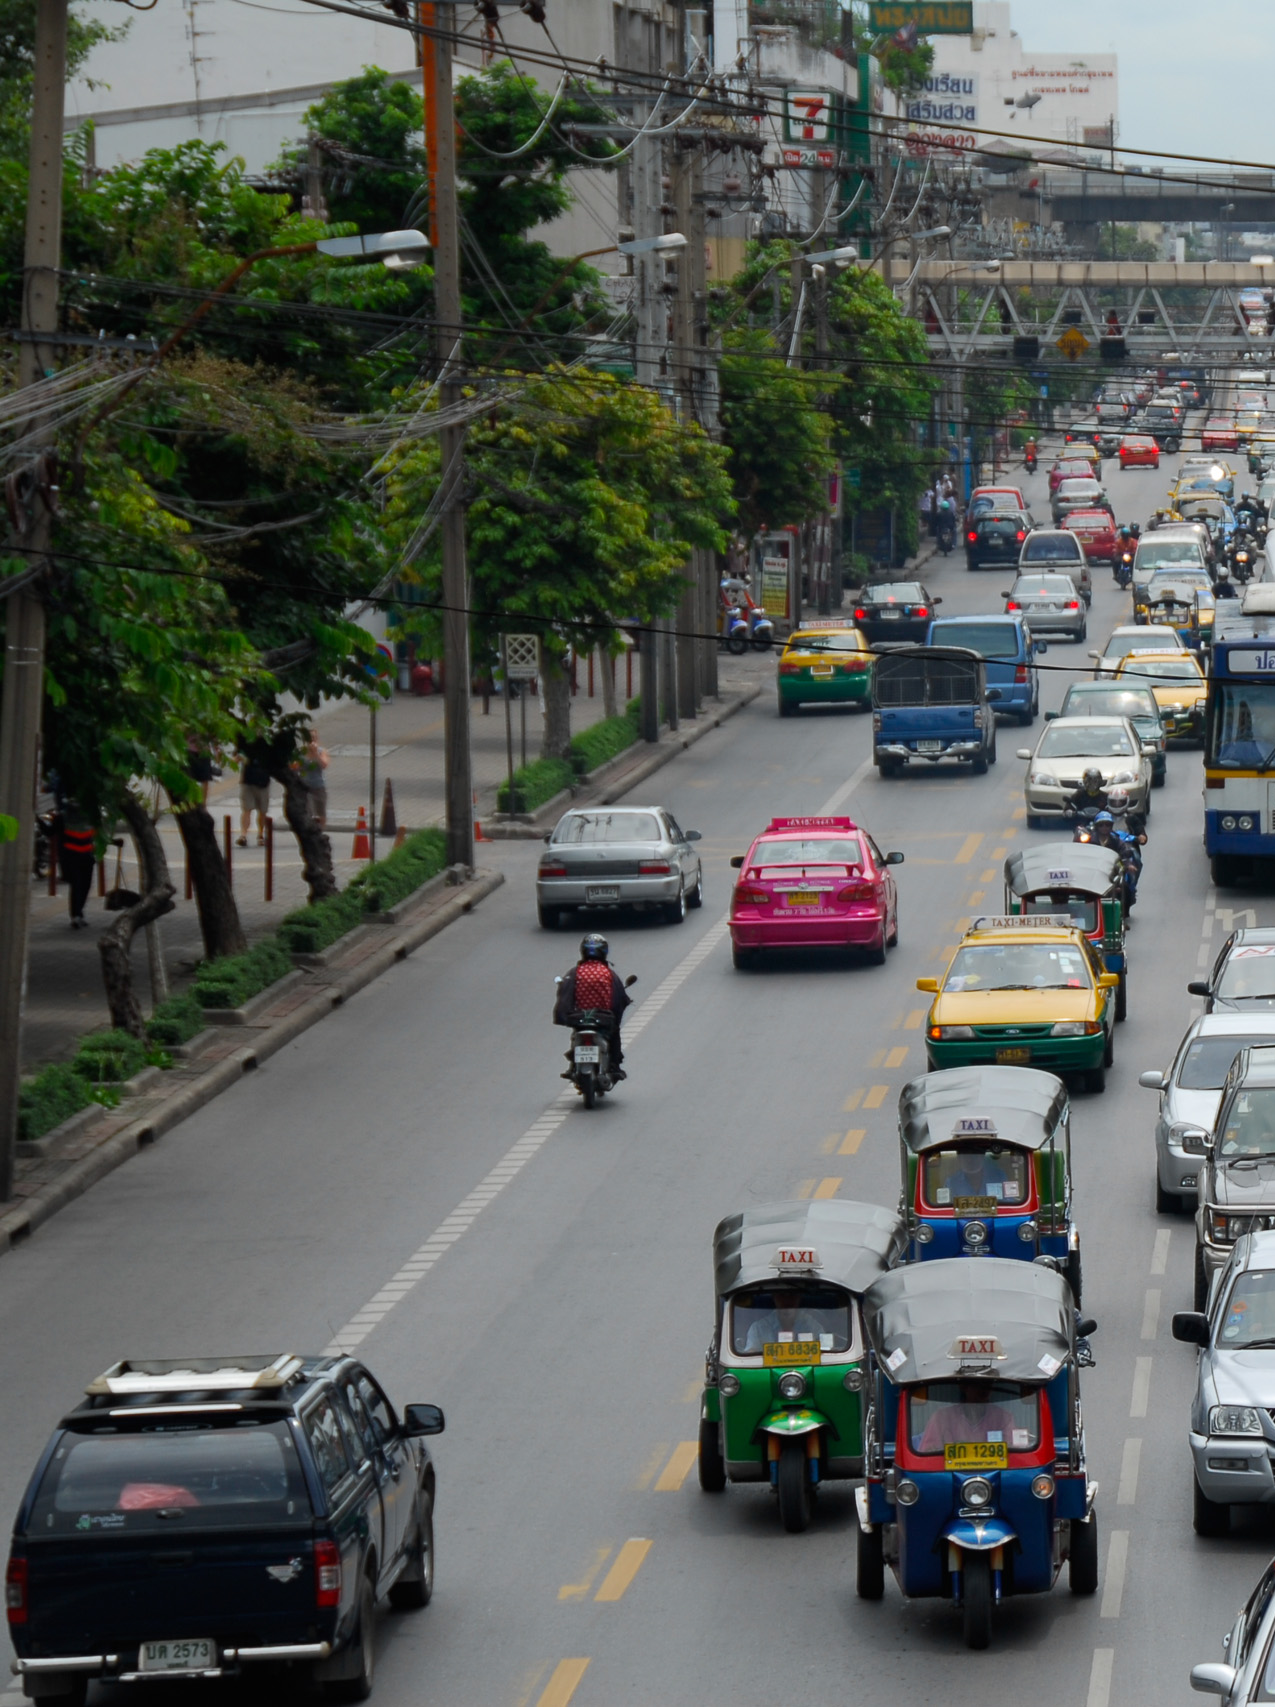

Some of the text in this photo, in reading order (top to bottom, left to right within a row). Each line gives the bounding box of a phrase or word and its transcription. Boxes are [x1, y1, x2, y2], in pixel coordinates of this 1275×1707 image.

[793, 97, 824, 140] 7
[801, 152, 816, 166] 24
[1049, 871, 1068, 879] TAXI
[991, 917, 1051, 928] TAXI-METER
[960, 1120, 988, 1130] TAXI
[779, 1251, 813, 1263] TAXI
[959, 1340, 995, 1354] TAXI
[948, 1443, 1005, 1459] สก 1298
[173, 1643, 209, 1659] 2573
